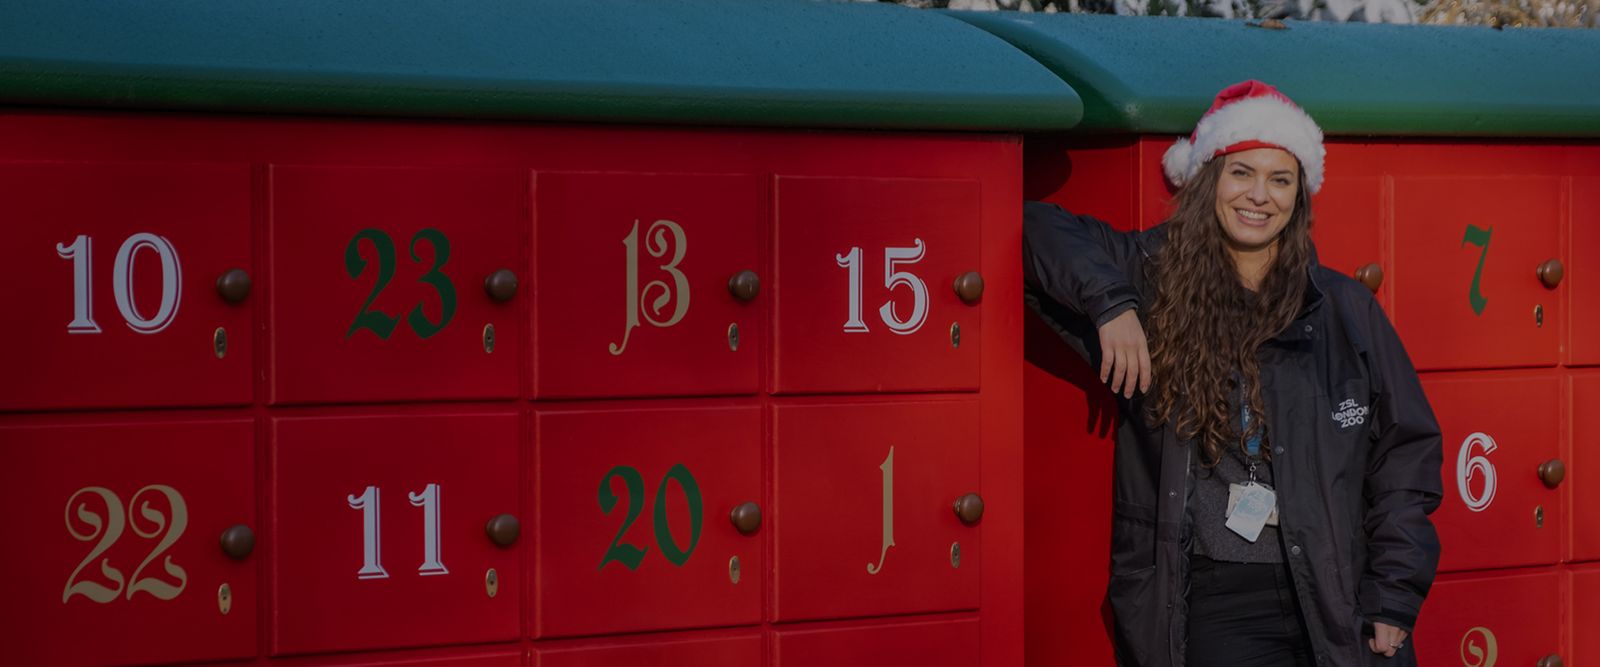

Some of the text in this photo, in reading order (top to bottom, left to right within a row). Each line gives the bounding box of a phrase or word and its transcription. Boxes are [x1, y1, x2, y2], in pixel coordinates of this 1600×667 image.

[56, 232, 182, 334] 10
[344, 228, 457, 340] 23
[609, 219, 690, 355] 13
[836, 238, 930, 335] 15
[1463, 224, 1493, 316] 7
[1338, 398, 1359, 411] ZSL
[1340, 416, 1364, 428] ZOO
[597, 463, 703, 572] 20
[1456, 432, 1498, 512] 6
[62, 484, 189, 604] 22
[347, 483, 449, 579] 11
